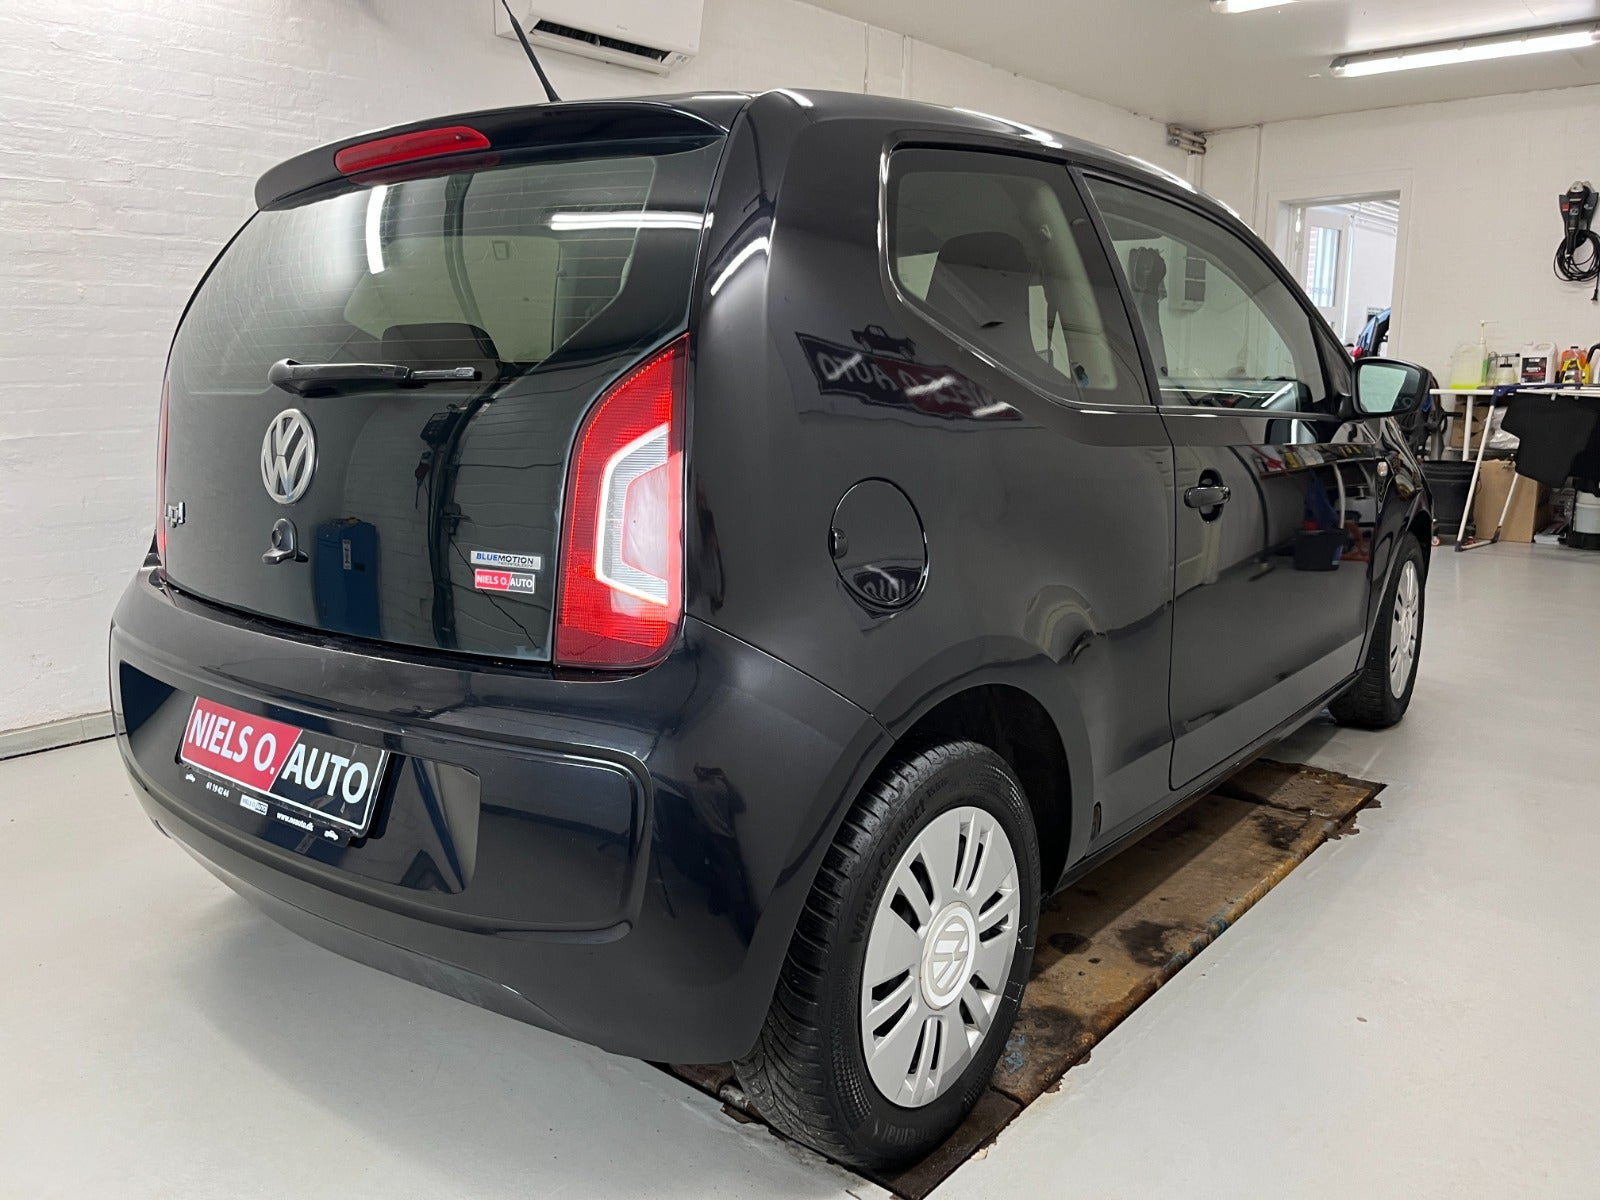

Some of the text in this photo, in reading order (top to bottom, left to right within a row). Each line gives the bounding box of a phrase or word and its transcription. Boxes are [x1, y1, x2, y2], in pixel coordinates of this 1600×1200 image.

[476, 552, 534, 565] BLUEMOTION
[476, 574, 499, 585] NIELS
[510, 578, 533, 588] AUTO
[188, 708, 369, 804] NIELS O. AUTO
